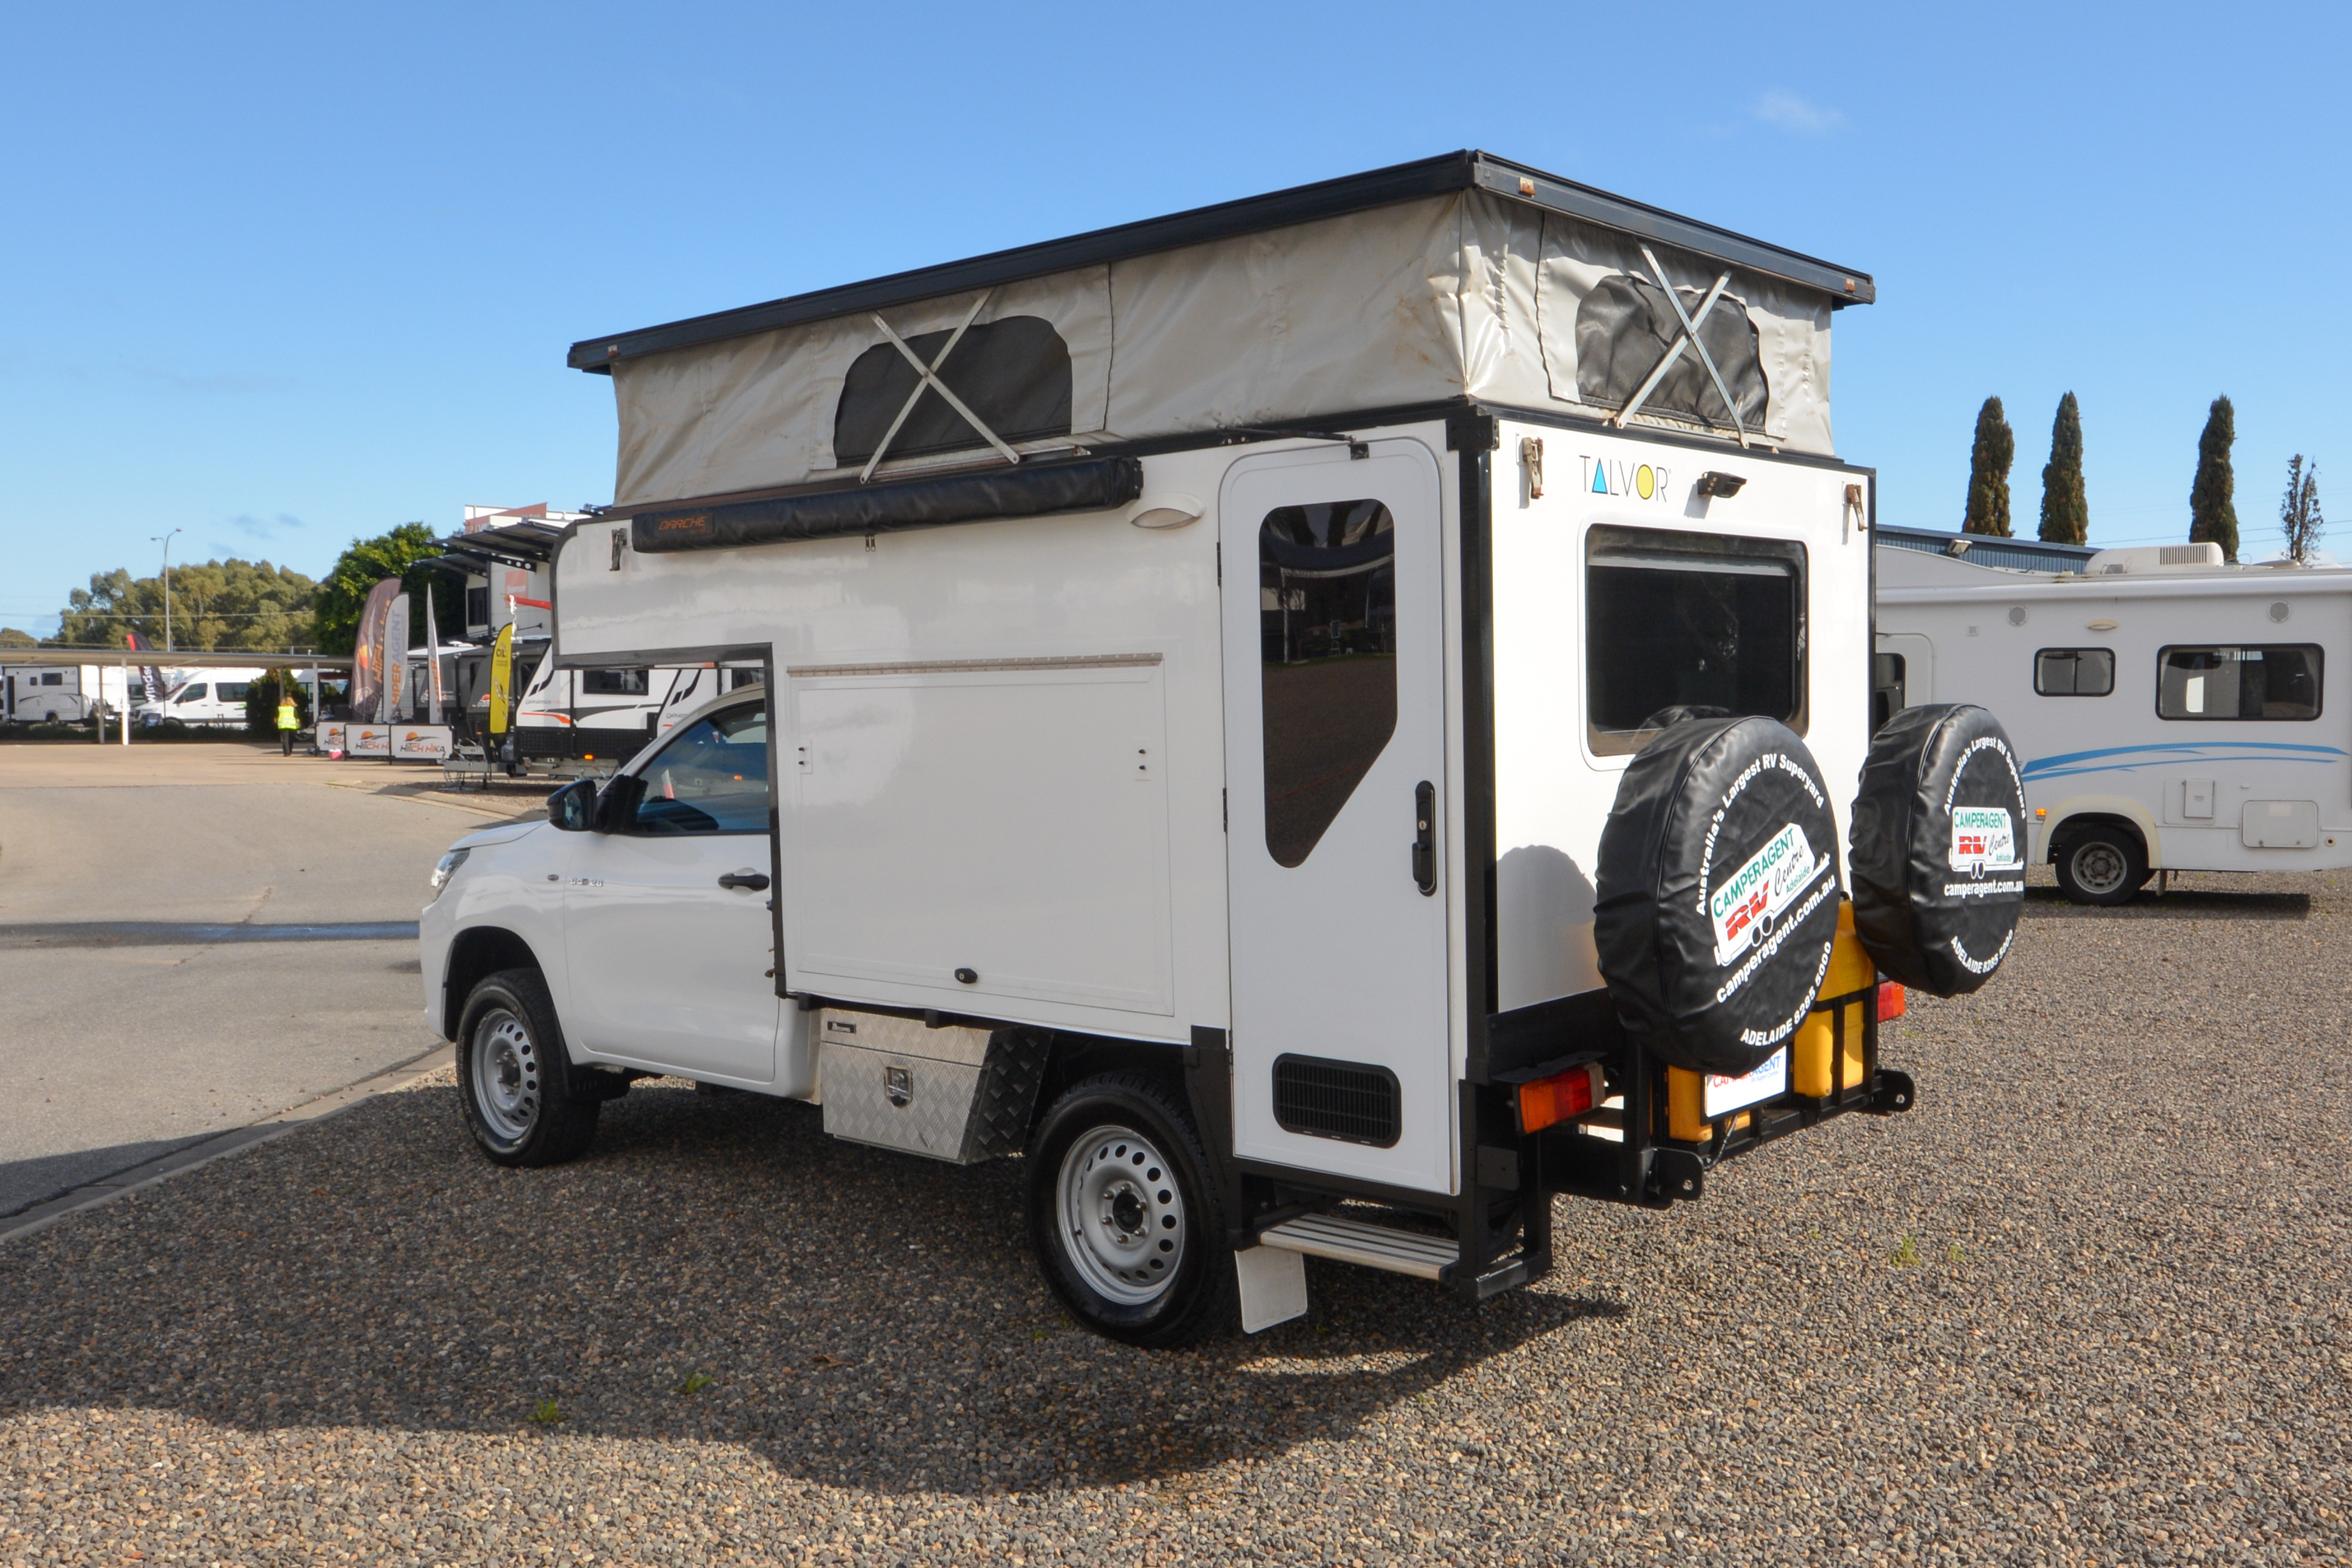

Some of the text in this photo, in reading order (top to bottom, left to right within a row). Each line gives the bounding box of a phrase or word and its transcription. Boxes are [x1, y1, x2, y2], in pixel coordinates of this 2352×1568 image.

[1579, 454, 1669, 503] TALVOR
[658, 515, 708, 531] DARCHE
[1944, 736, 2026, 820] Australia's Largest RV Superyard
[1697, 753, 1824, 916] Australia's Largest RV Superyard
[1954, 811, 2006, 829] CAMPERAGENT
[1958, 834, 2010, 857] RV Centre
[1714, 828, 1794, 918] CAMPERAGENT
[1725, 844, 1804, 942] RV Centre
[1786, 865, 1810, 894] Adelaide
[1944, 879, 2024, 899] camperagent.com.au
[1716, 874, 1836, 1003] camperagent.com.au
[1950, 928, 2013, 974] ADELAIDE 8285 5000
[1740, 941, 1831, 1047] ADELAIDE 8285 5000
